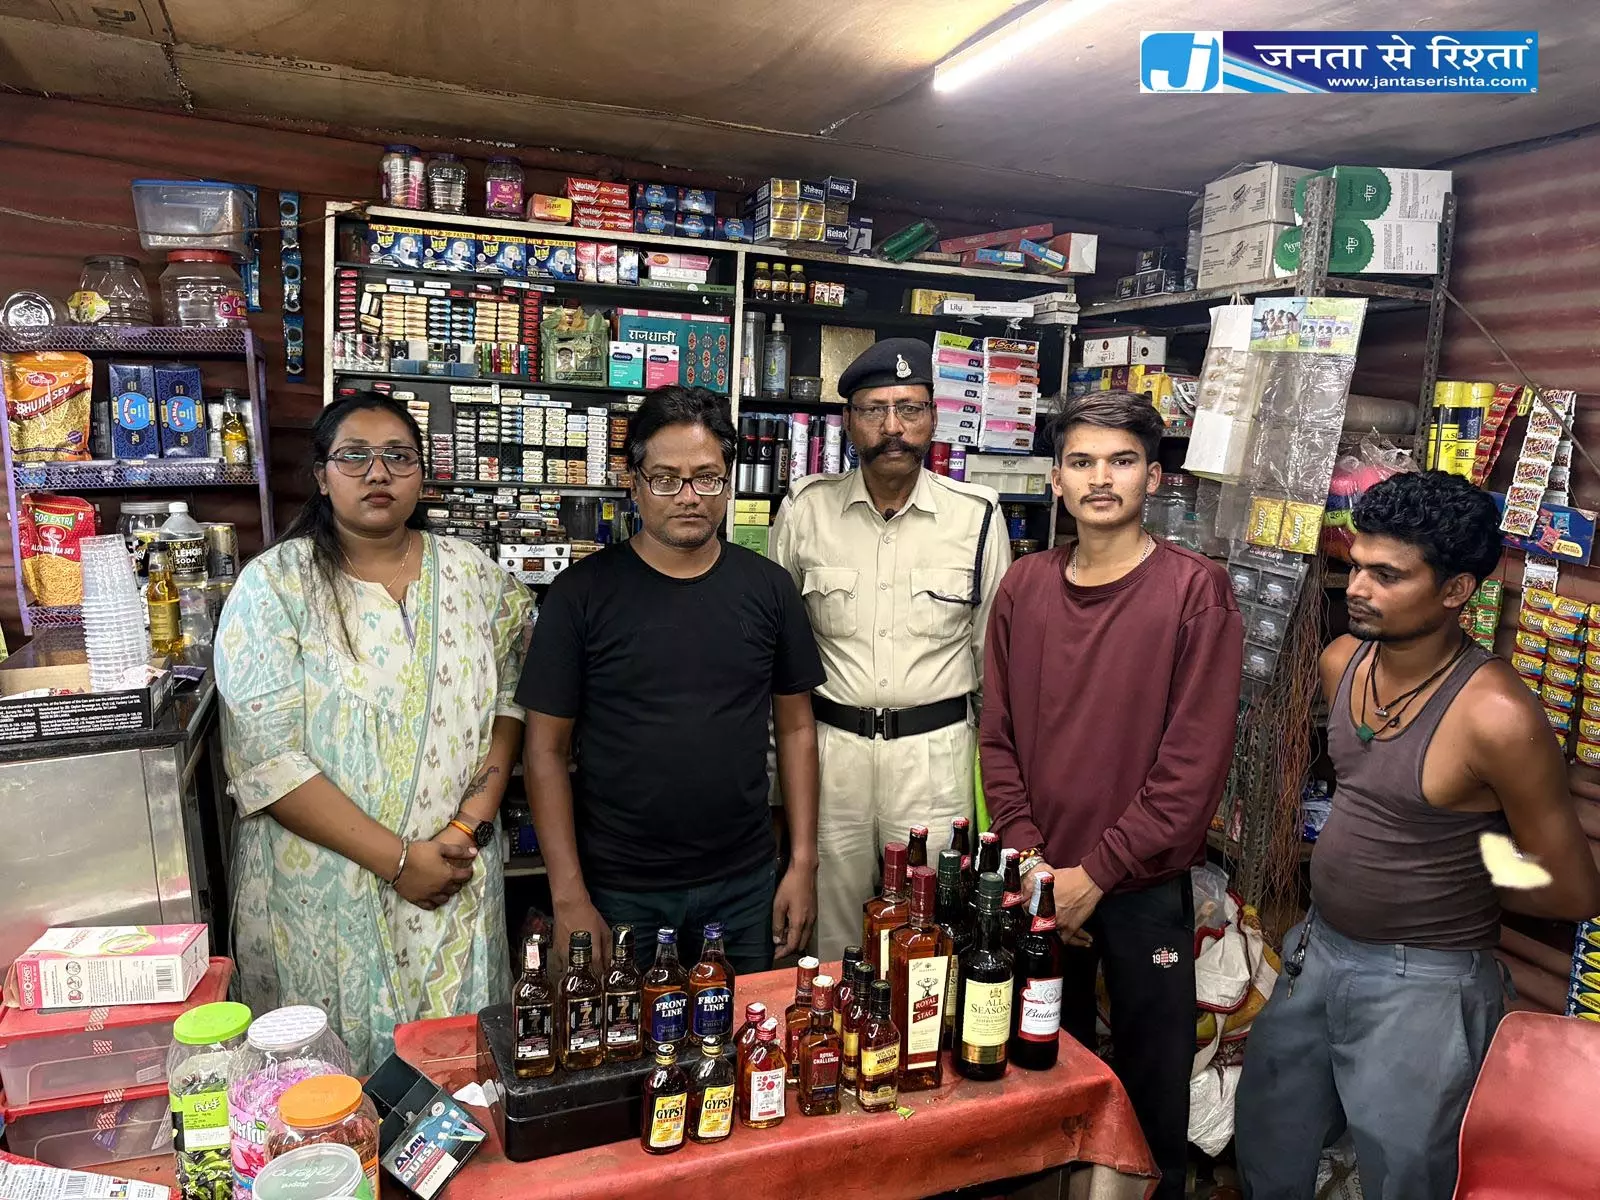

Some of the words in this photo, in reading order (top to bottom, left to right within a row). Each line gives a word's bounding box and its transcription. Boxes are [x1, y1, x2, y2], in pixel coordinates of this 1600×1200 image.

[826, 229, 848, 240] Relax
[950, 303, 962, 312] Lily
[52, 385, 70, 400] SEV
[50, 516, 73, 527] EXTRA
[1254, 507, 1267, 537] Sunny
[1290, 513, 1304, 544] Sunny
[1152, 953, 1161, 964] 19
[1168, 952, 1178, 963] 96
[655, 998, 687, 1012] FRONT
[697, 994, 730, 1005] FRONT
[915, 997, 937, 1010] ROYAL
[985, 999, 1004, 1007] ALL
[661, 1007, 683, 1018] LINE
[703, 1002, 725, 1012] LINE
[917, 1009, 934, 1021] STAG
[813, 1056, 839, 1065] CHALLENGE
[705, 1096, 733, 1109] GYPSY
[656, 1105, 685, 1120] GYPSY
[403, 1141, 437, 1182] QUEST
